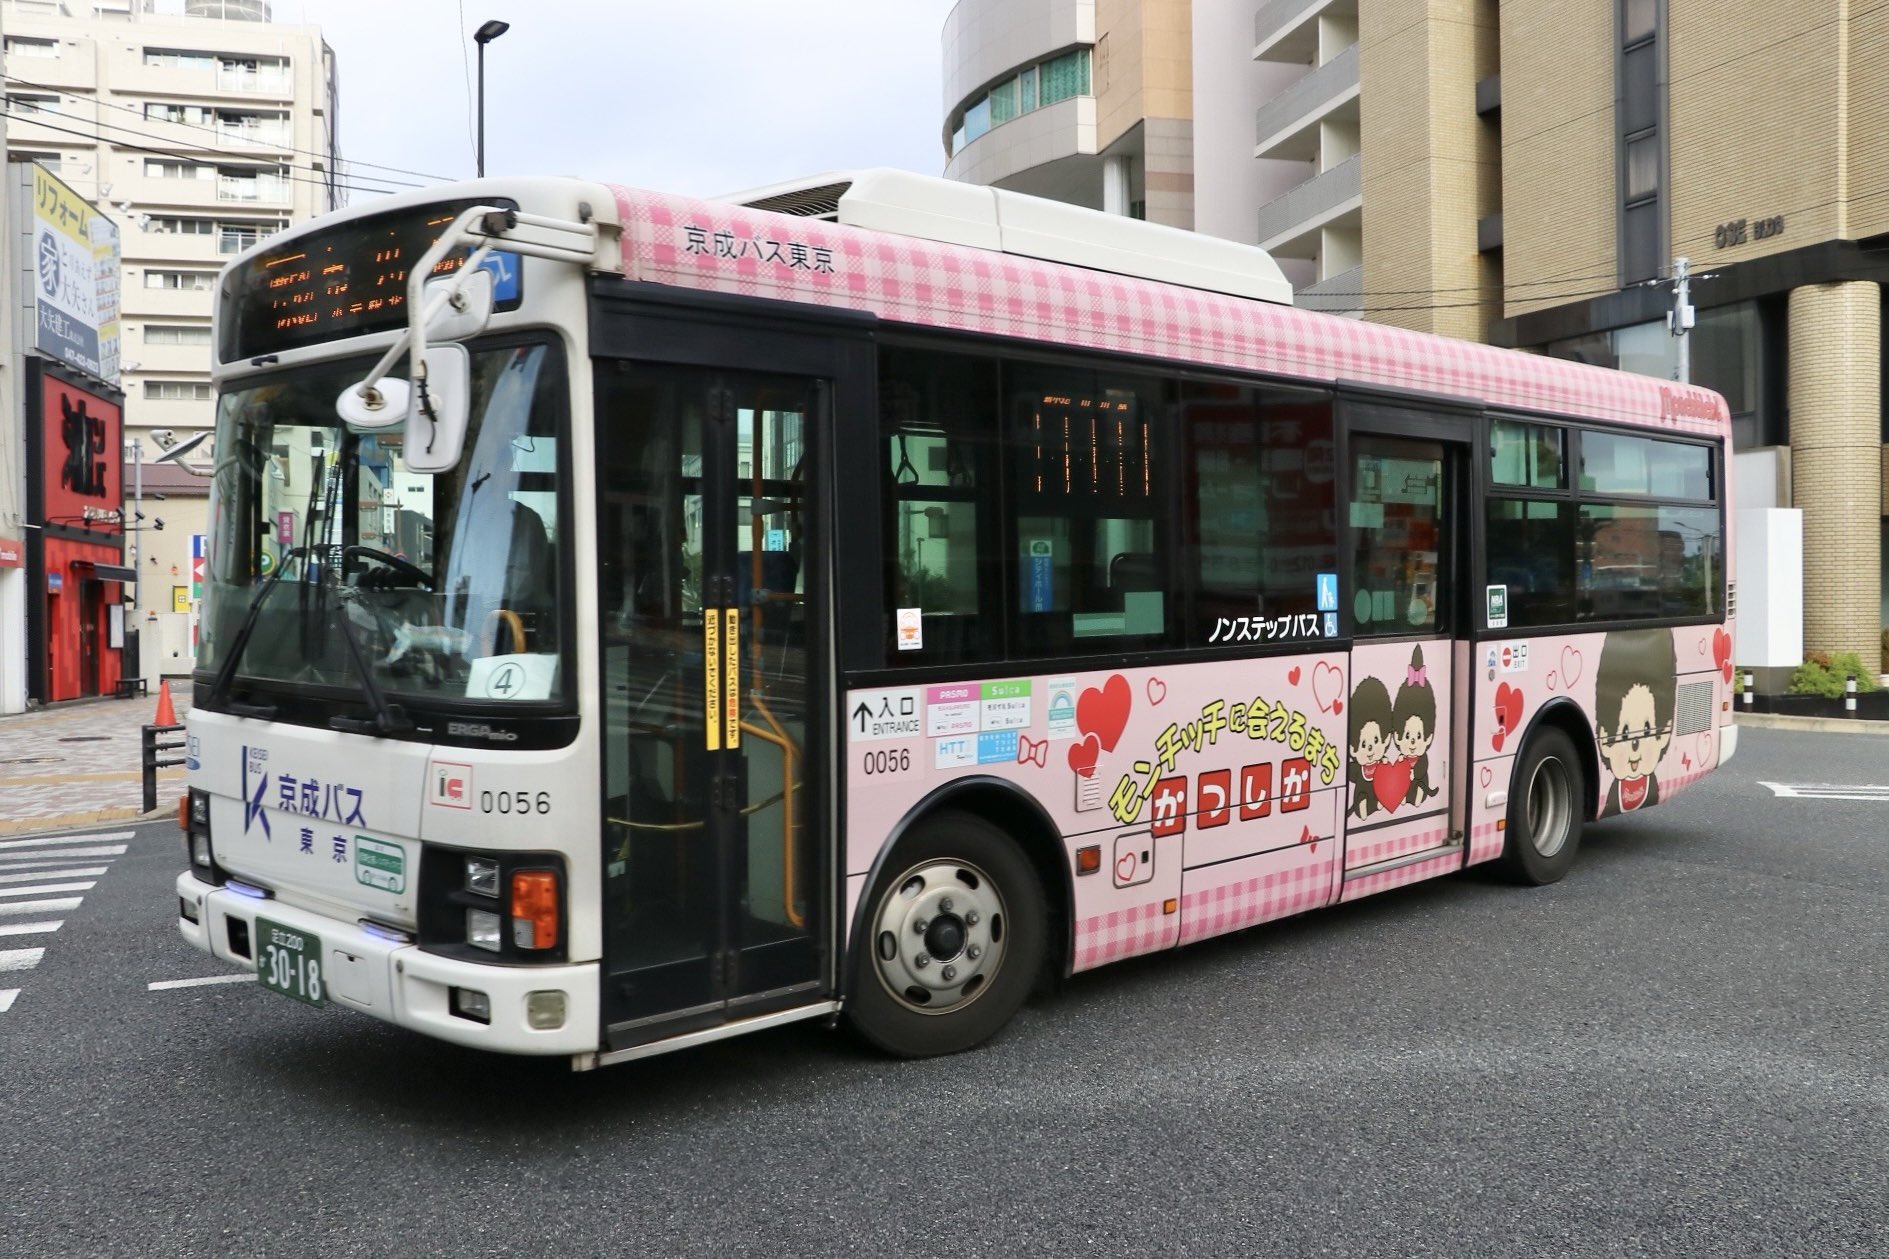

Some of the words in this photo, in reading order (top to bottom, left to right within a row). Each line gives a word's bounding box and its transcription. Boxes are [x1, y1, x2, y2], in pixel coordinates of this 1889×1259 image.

[37, 174, 89, 240] リフォーム
[684, 225, 835, 274] 京成バス東京
[1208, 614, 1320, 643] ノンステップバス
[991, 686, 1020, 696] Suica
[878, 696, 914, 719] 入口
[872, 719, 920, 736] ENTRANCE
[249, 761, 263, 775] BUS
[864, 748, 911, 776] 0056
[1108, 696, 1341, 825] モンチッチに会えるまち
[278, 773, 367, 829] 京成バス
[481, 791, 551, 815] 0056
[300, 827, 347, 864] 東京
[266, 945, 321, 1001] 30-18
